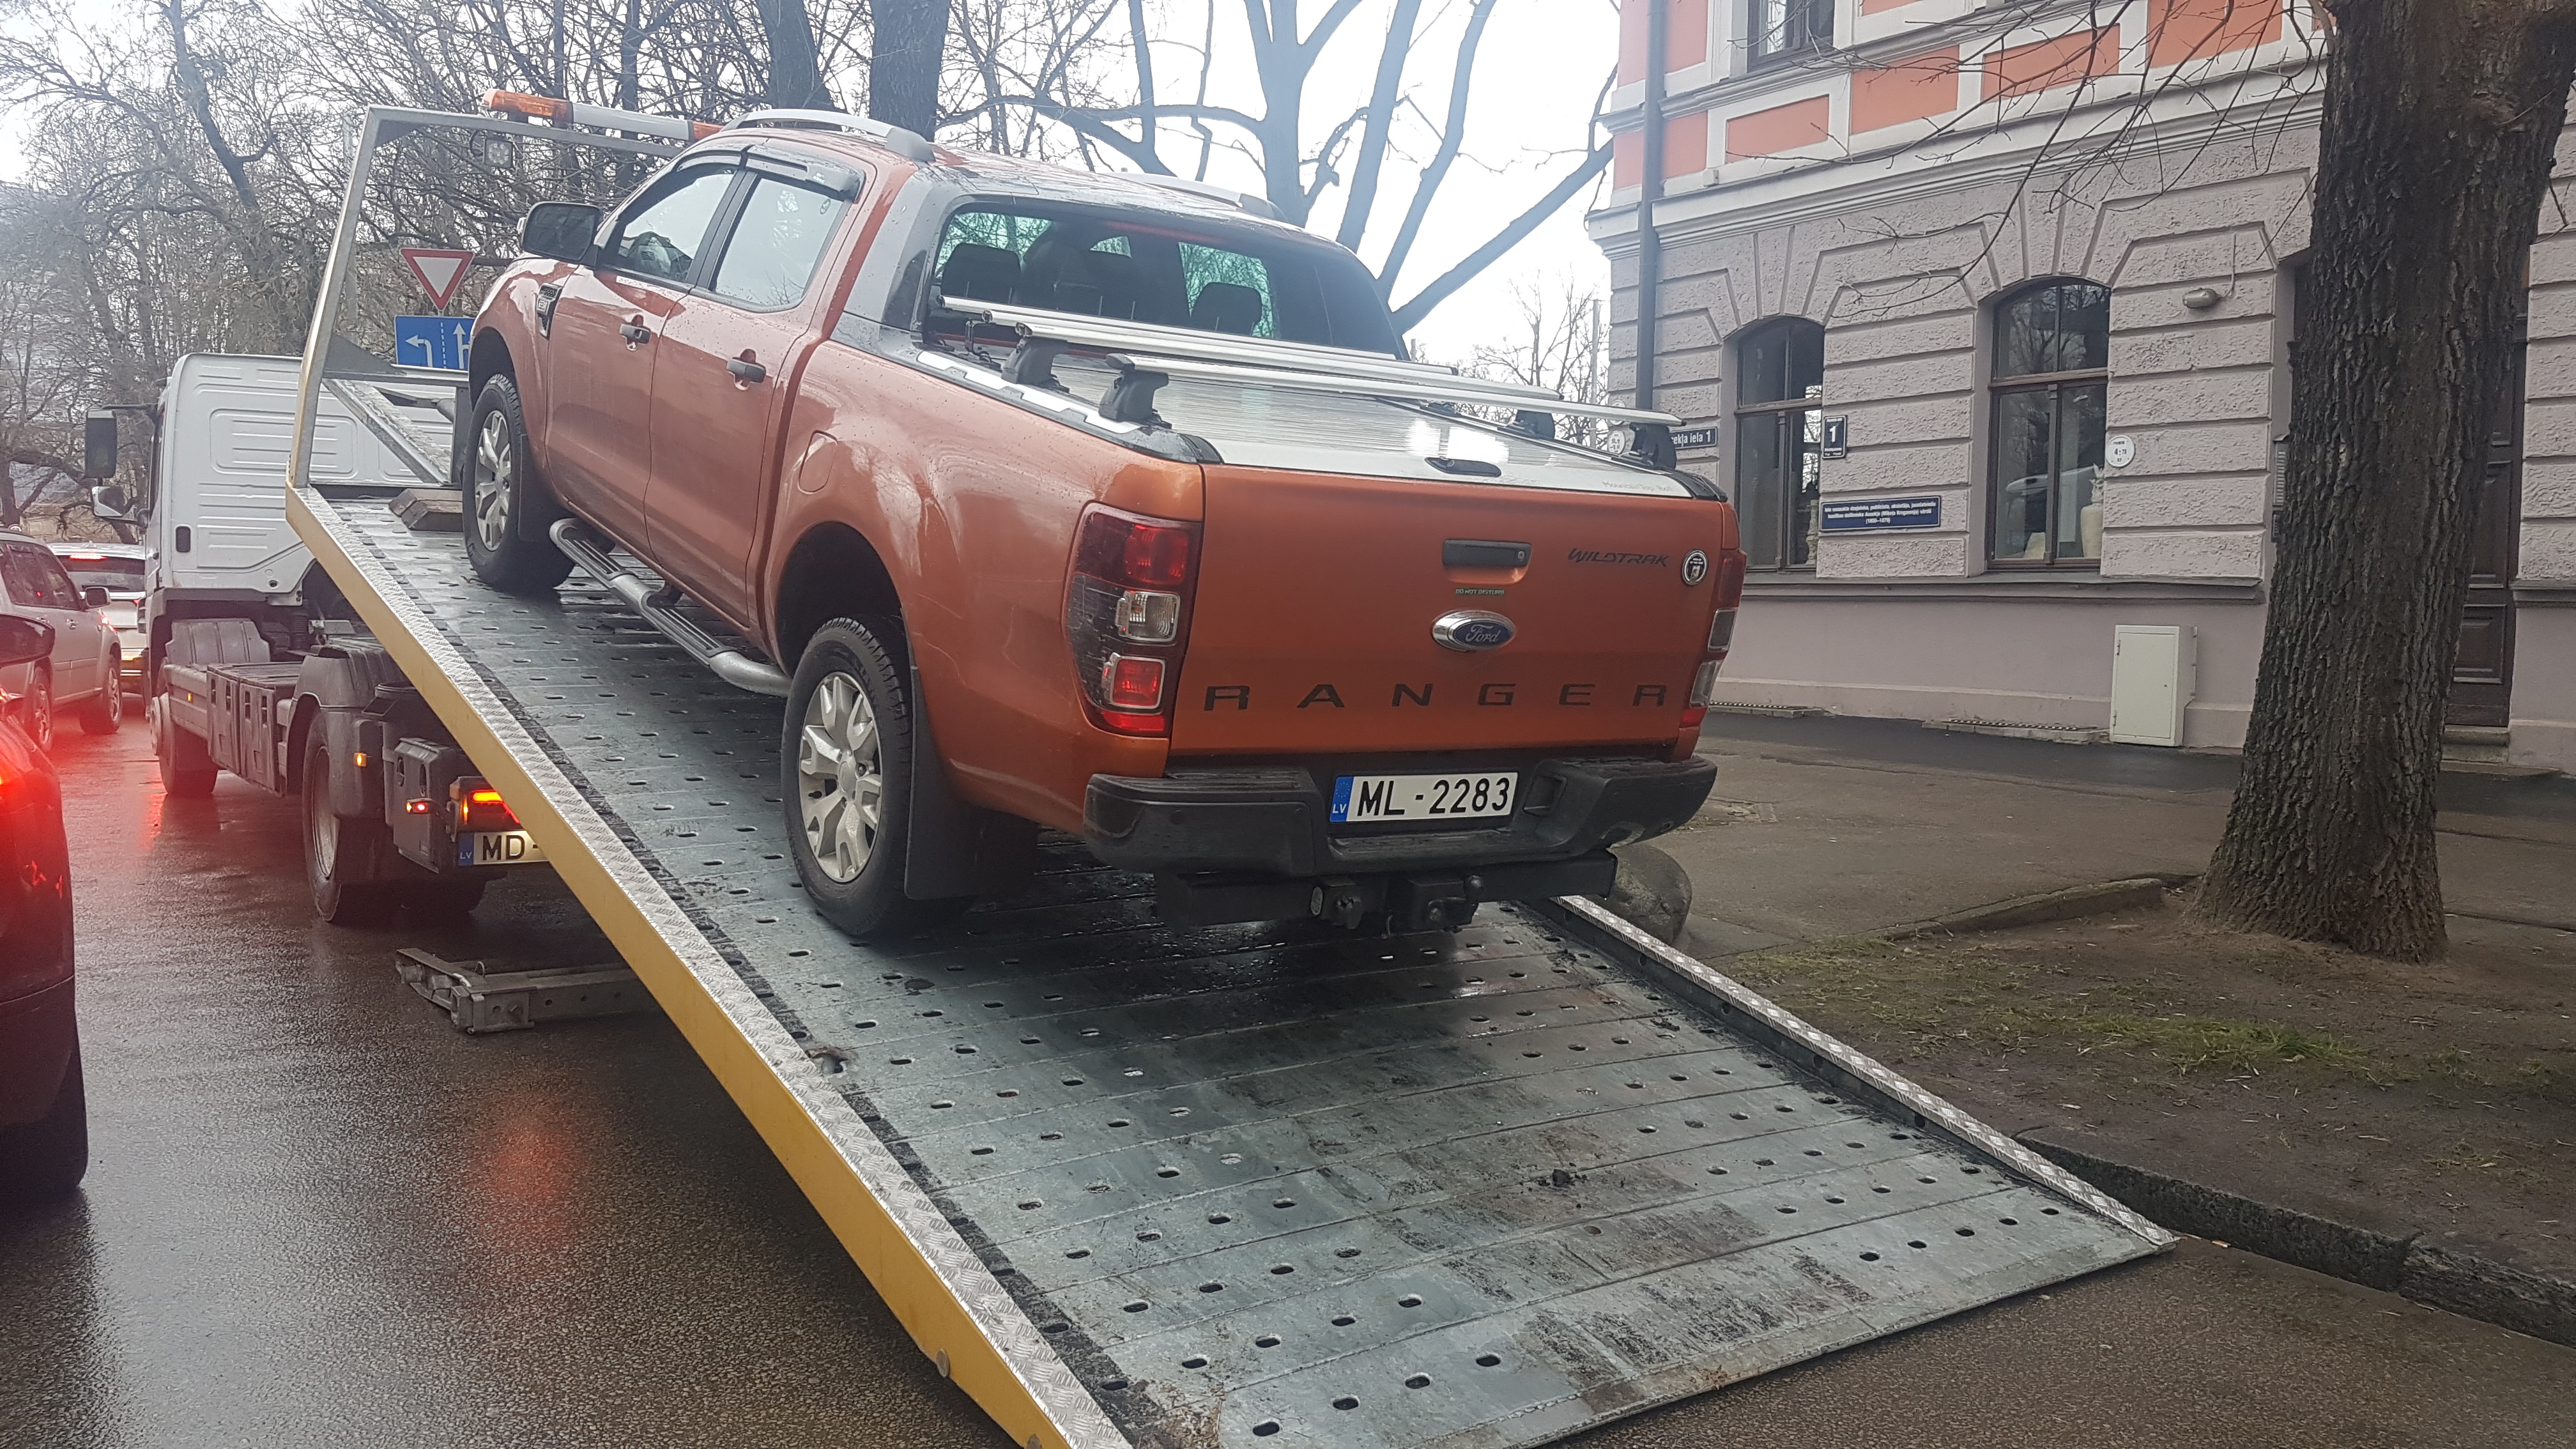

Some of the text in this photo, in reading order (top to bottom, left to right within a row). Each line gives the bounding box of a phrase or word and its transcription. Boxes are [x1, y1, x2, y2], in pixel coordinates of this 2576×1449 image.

[1690, 433, 1703, 443] iela
[1706, 429, 1711, 443] 1
[1829, 425, 1836, 442] 1
[1568, 548, 1670, 567] WILDTRAK
[1465, 624, 1501, 643] Ford
[1204, 683, 1667, 711] RANGER
[1331, 803, 1347, 814] LV
